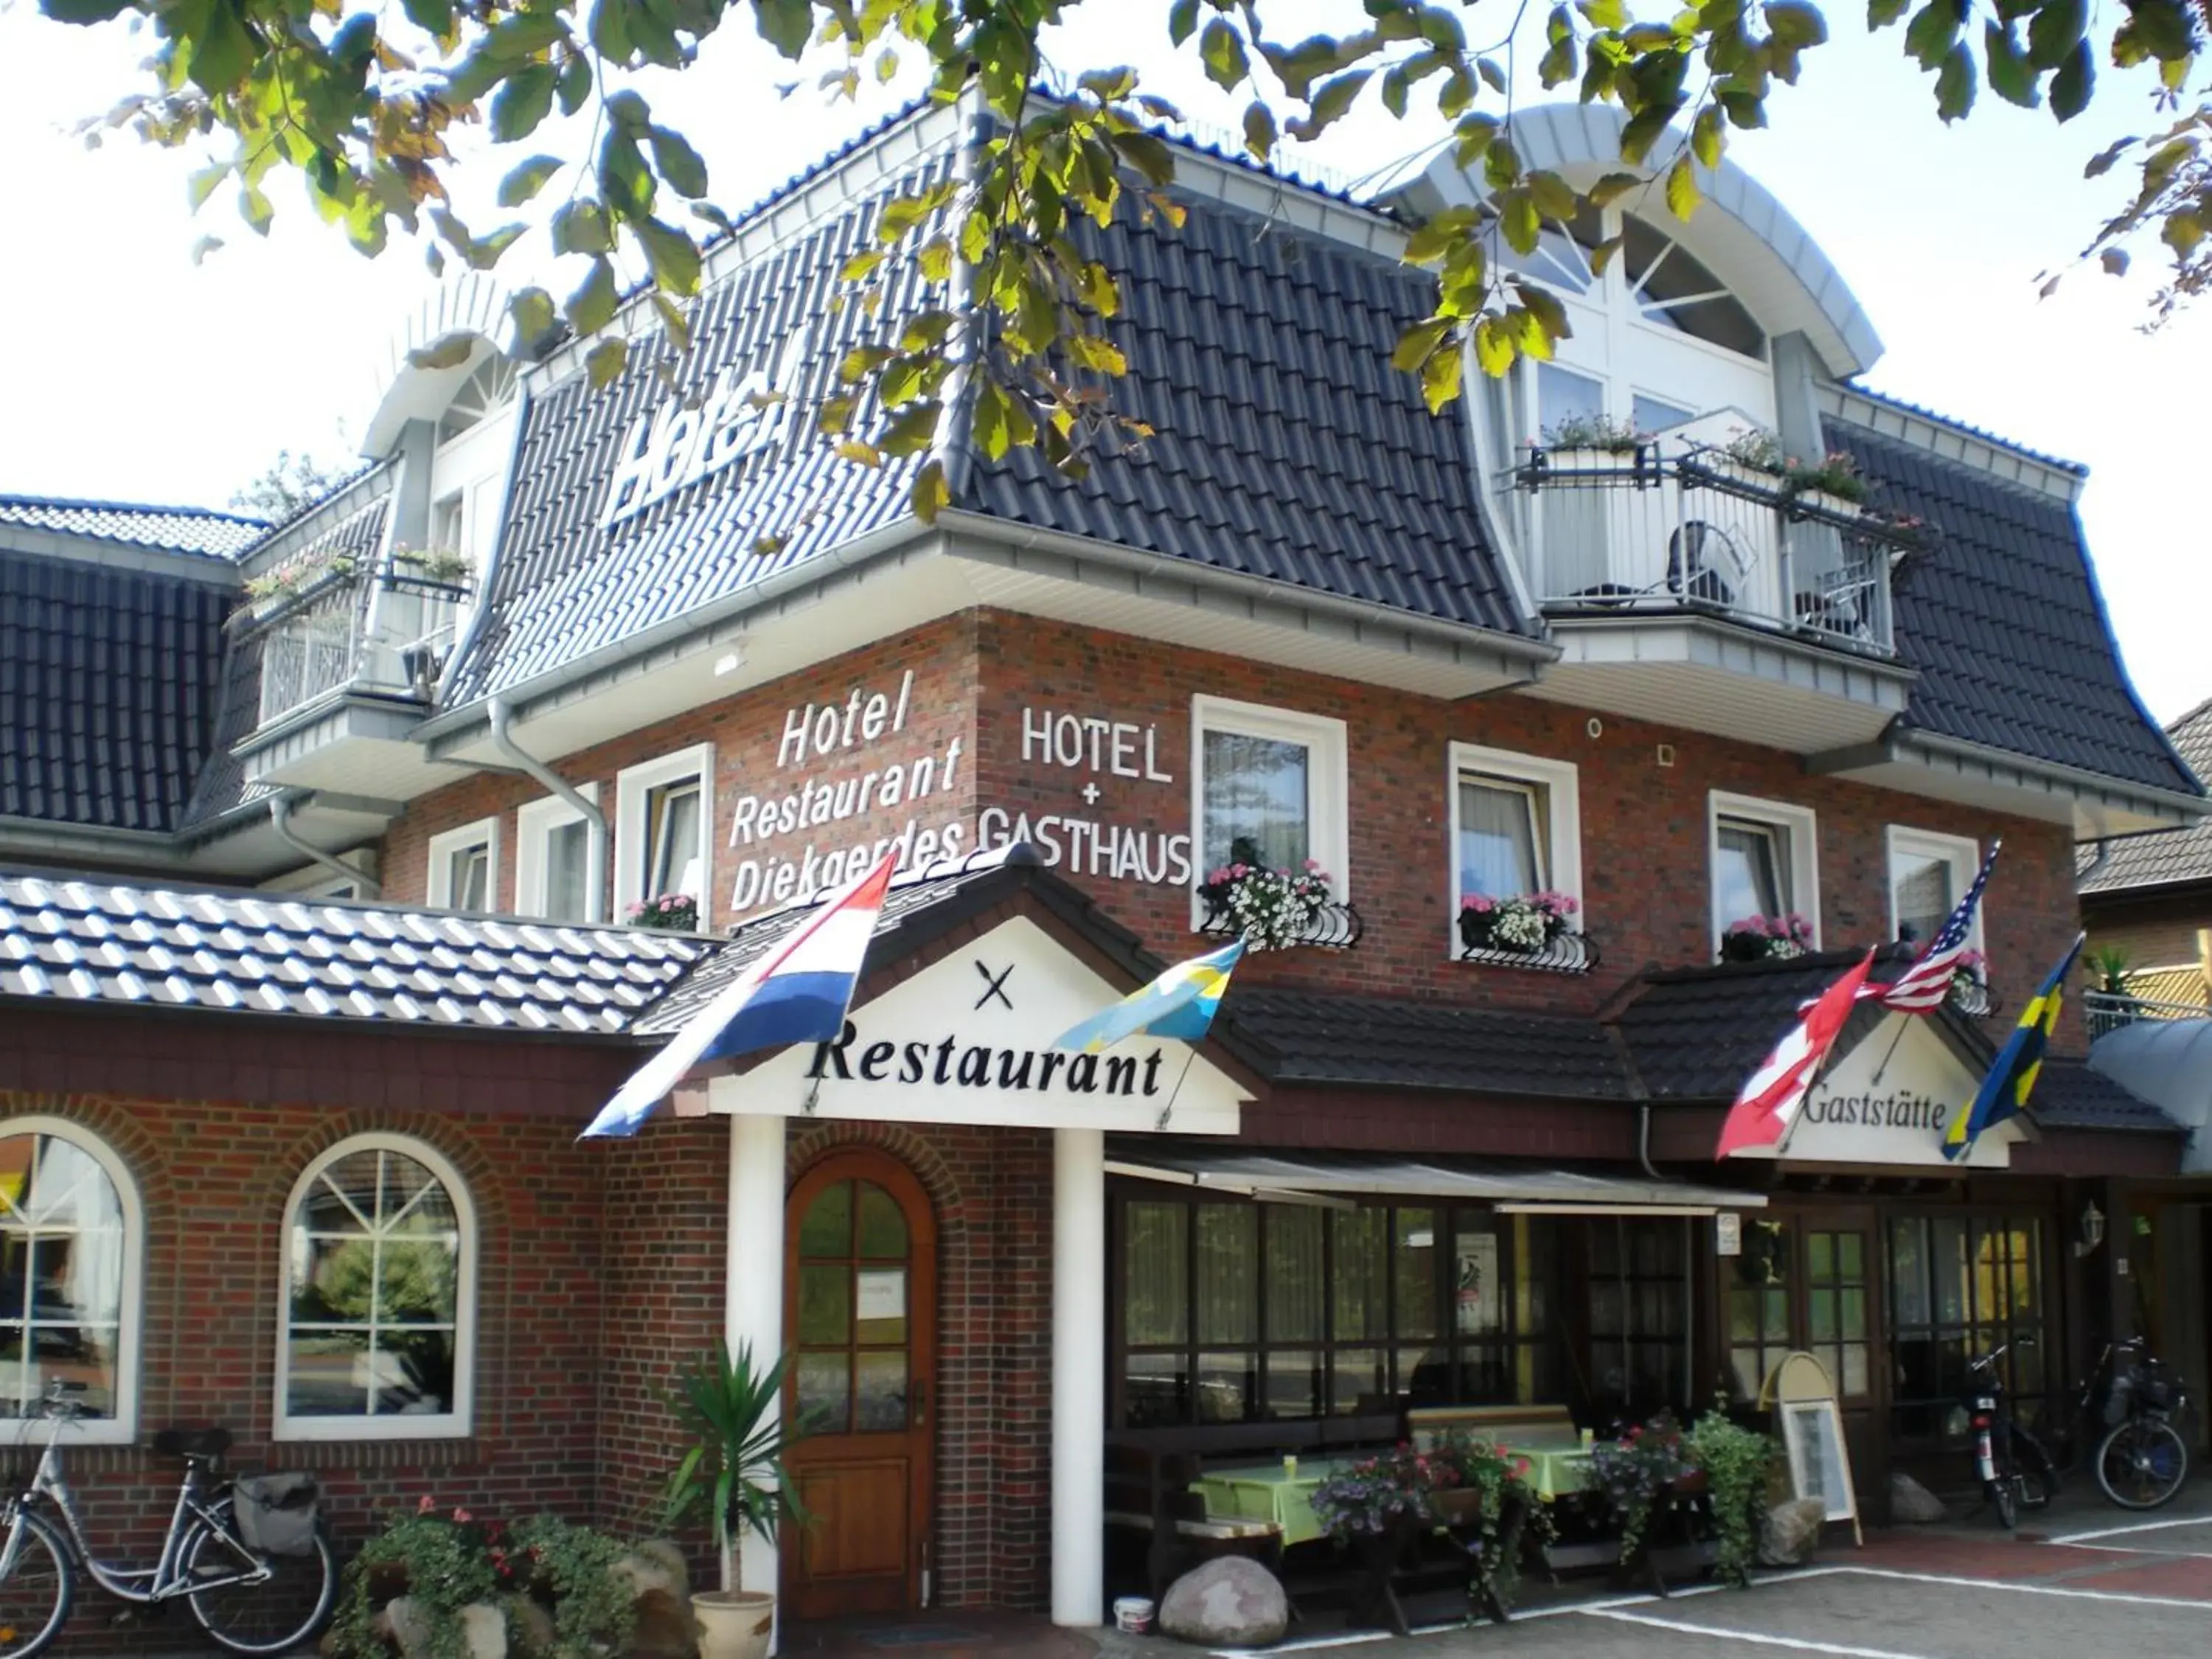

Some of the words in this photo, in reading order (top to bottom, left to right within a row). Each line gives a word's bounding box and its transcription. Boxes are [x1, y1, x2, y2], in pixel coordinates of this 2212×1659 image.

[776, 669, 914, 768] Hotel
[1021, 706, 1174, 783] HOTEL
[728, 737, 961, 848] Restaurant
[731, 819, 964, 911] Diekgerdes
[978, 807, 1193, 886] GASTHAUS
[804, 1020, 1163, 1097] Restaurant
[1806, 1082, 1947, 1130] Gaststätte
